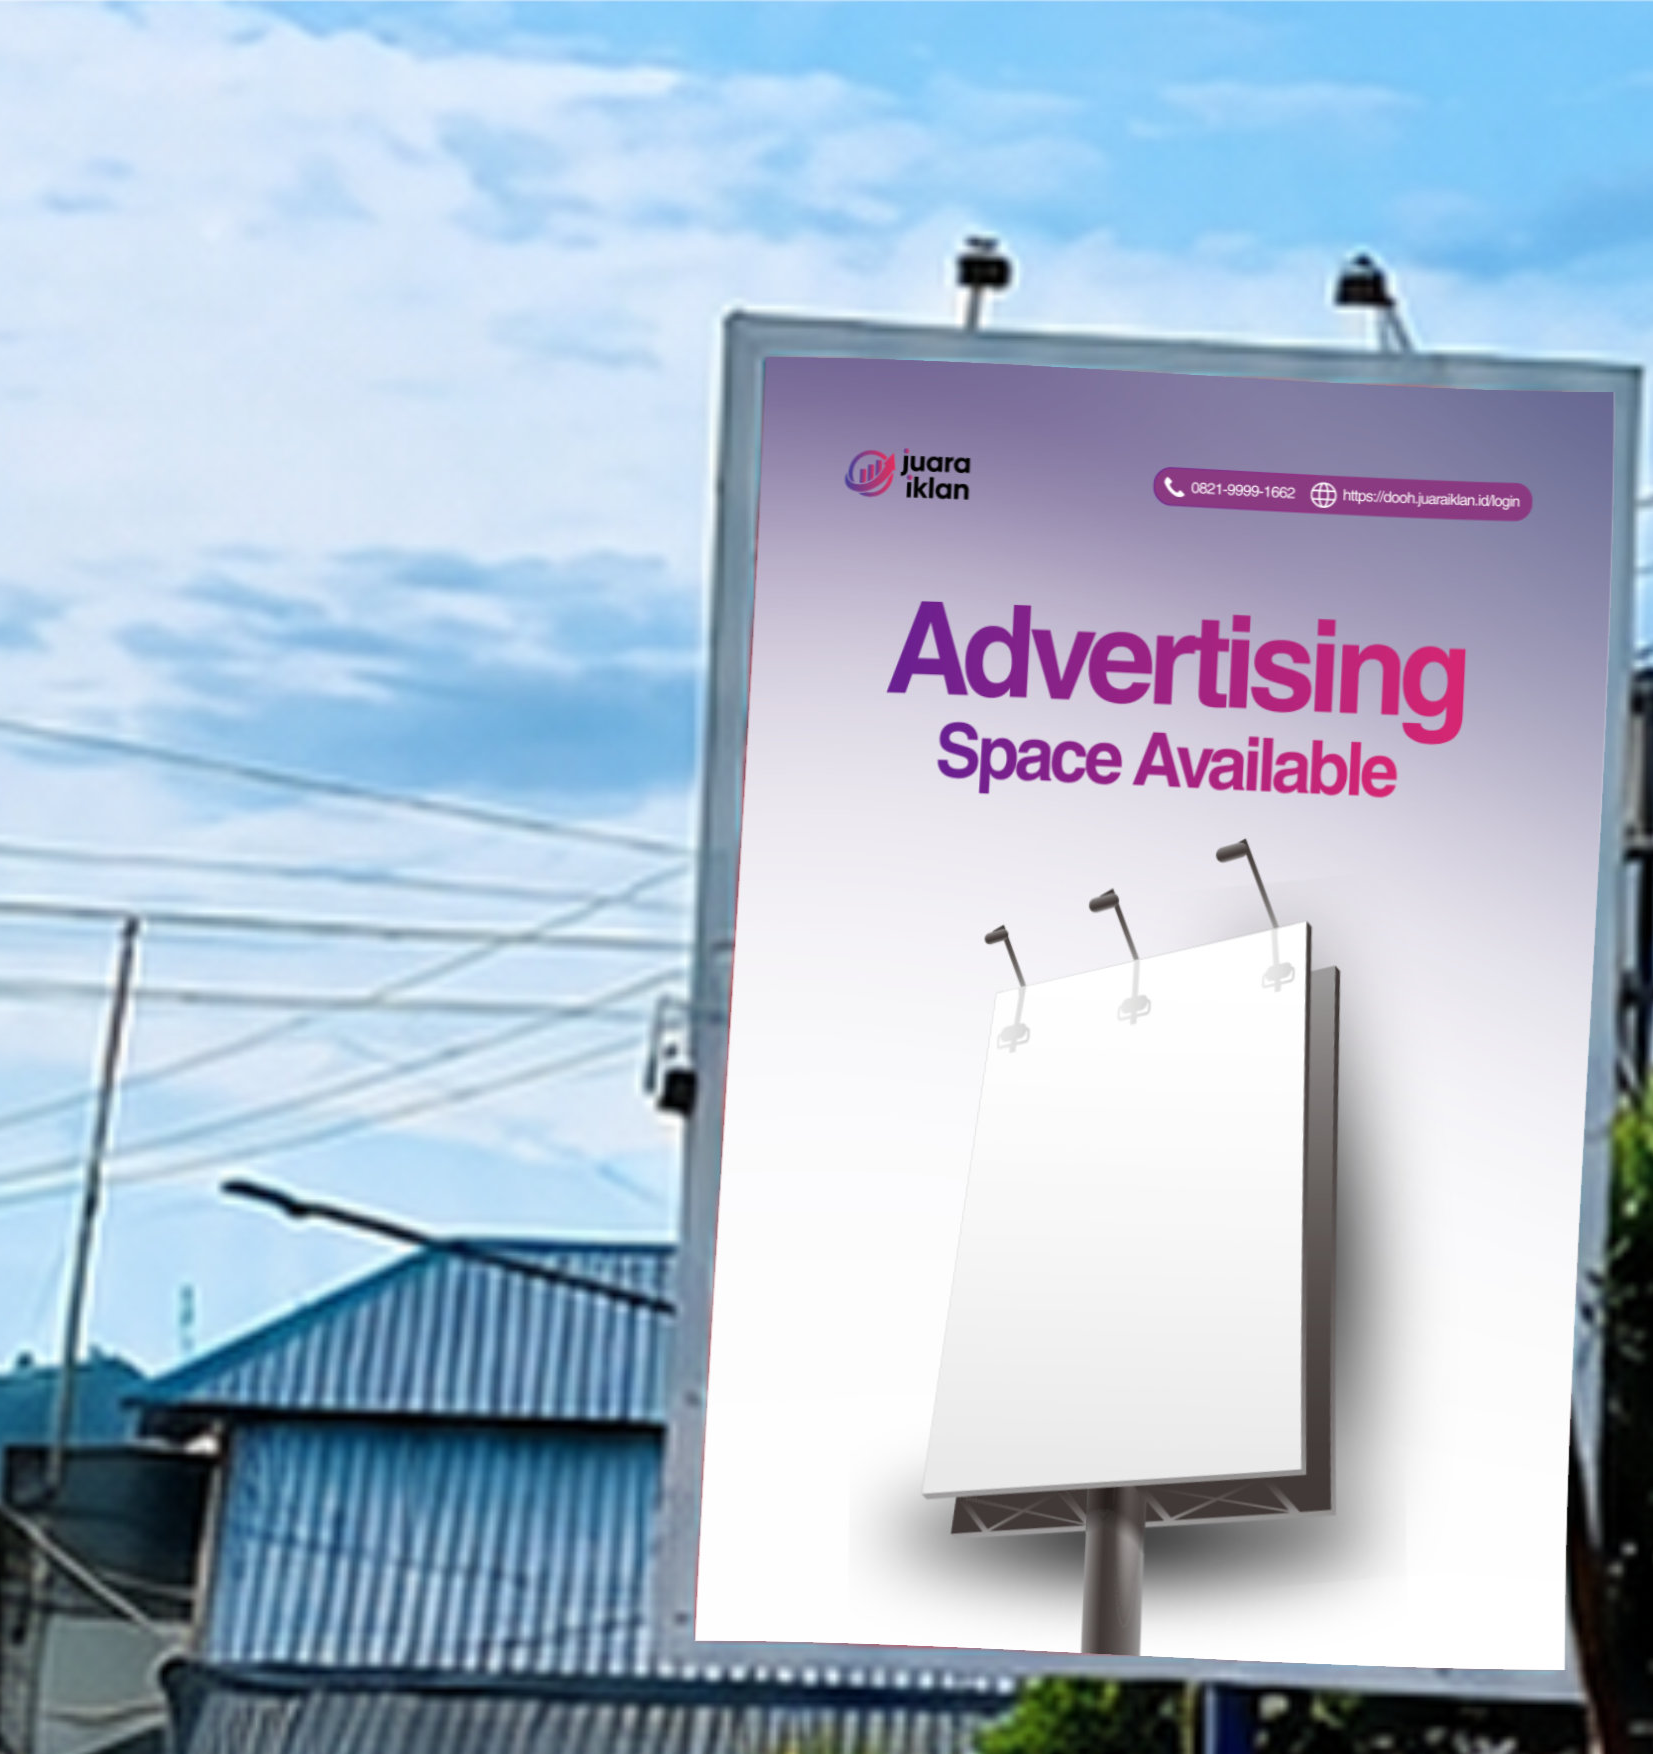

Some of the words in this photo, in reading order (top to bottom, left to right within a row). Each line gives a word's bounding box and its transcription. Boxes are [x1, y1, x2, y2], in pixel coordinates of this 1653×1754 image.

[900, 447, 971, 477] juara
[905, 474, 970, 501] iklan
[1190, 481, 1296, 500] 0821-9999-1662
[1342, 488, 1521, 510] https://dooh.juaraiklan.id/login
[887, 600, 1467, 745] Advertising
[936, 721, 1122, 794] Space
[1132, 731, 1399, 799] Available
